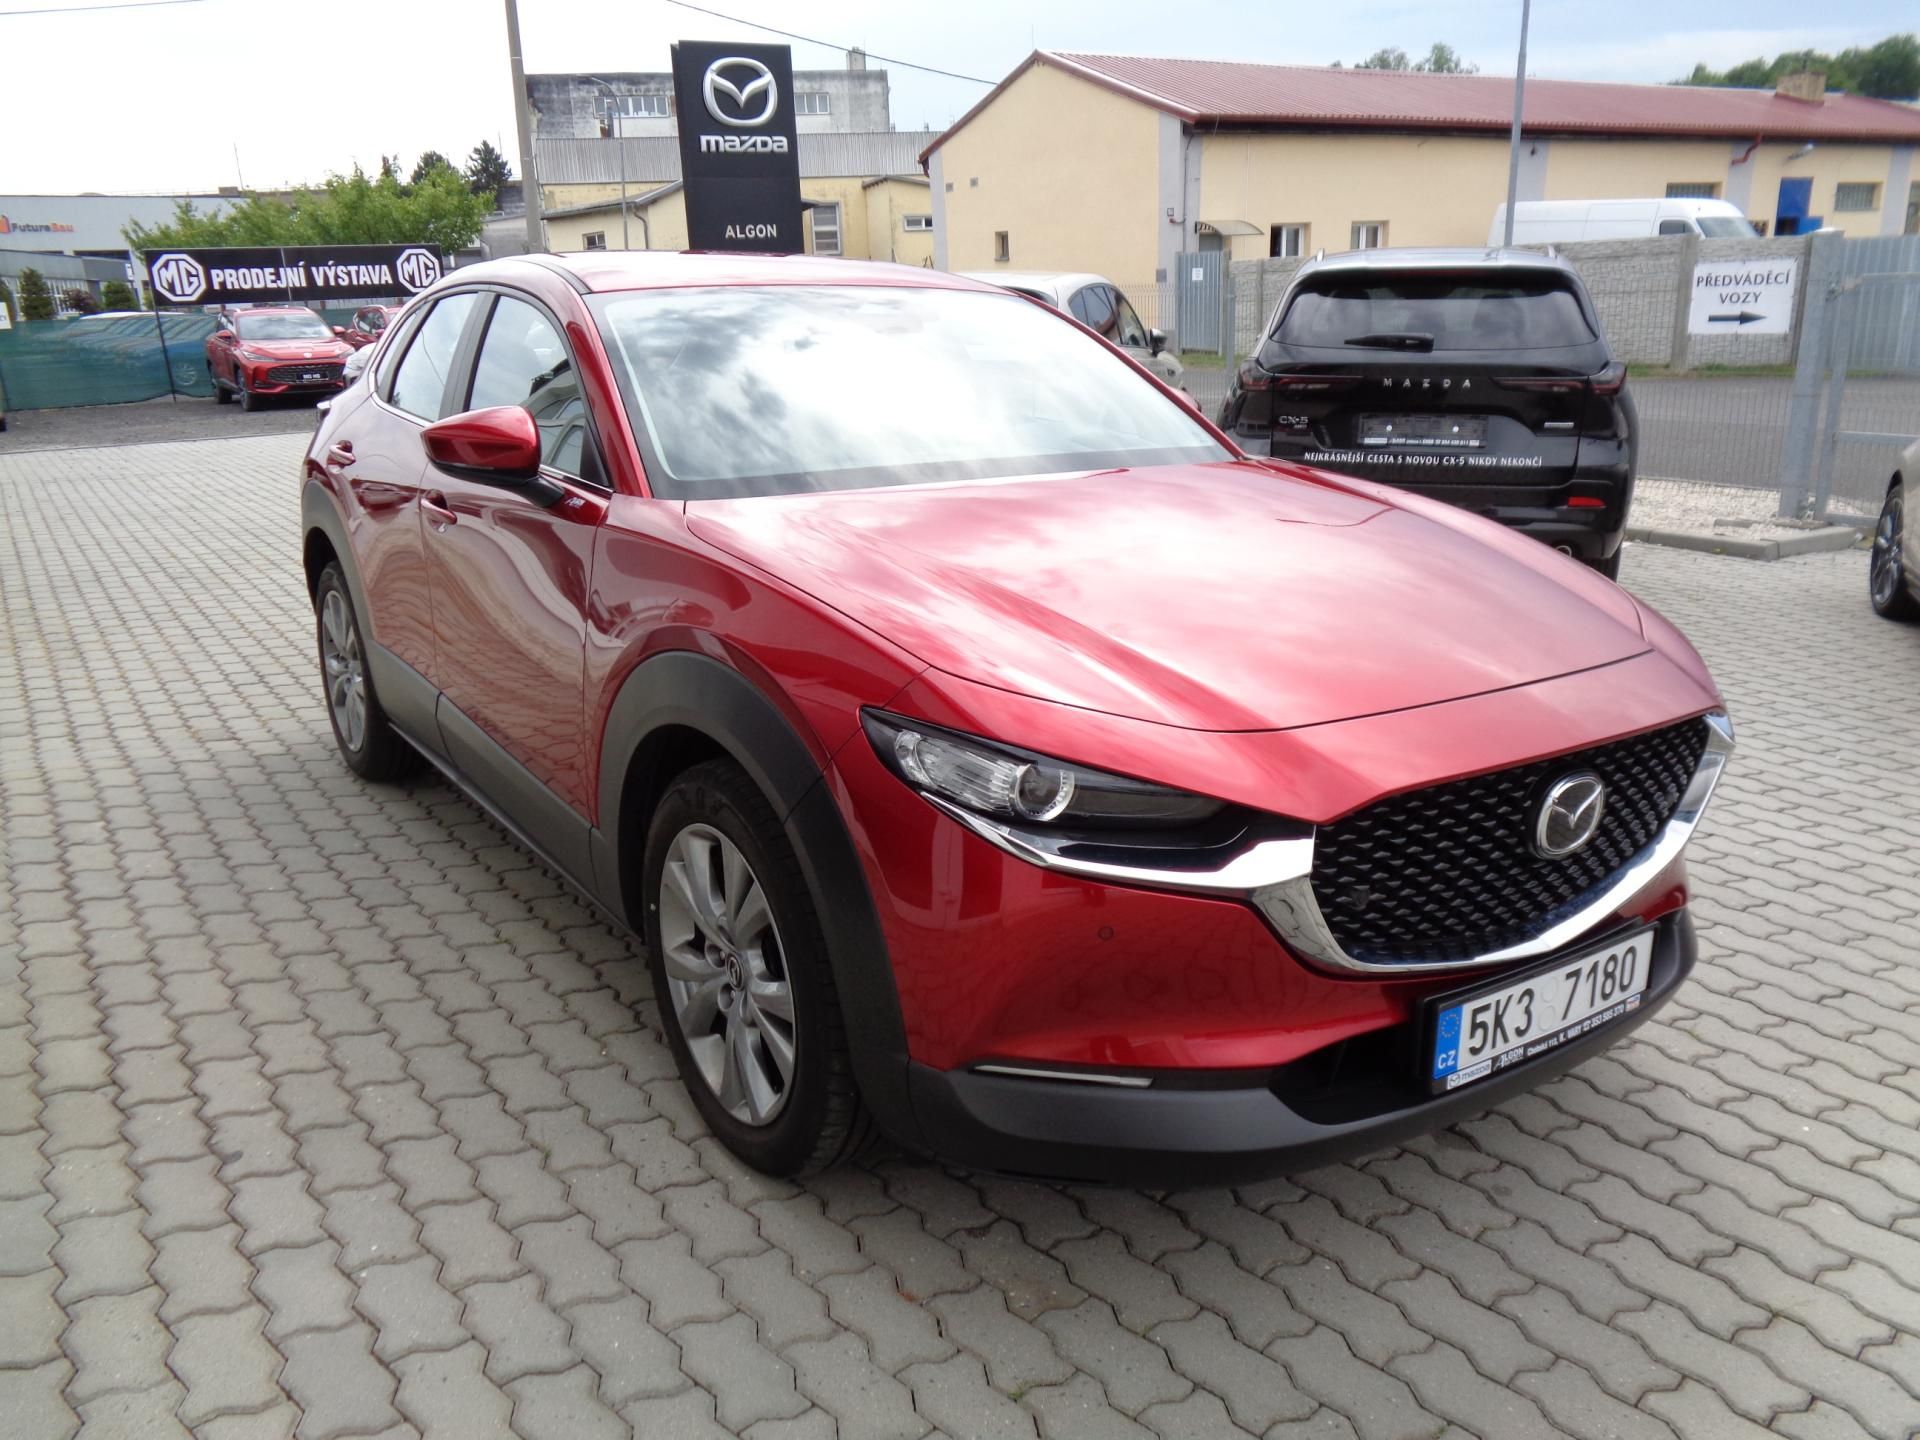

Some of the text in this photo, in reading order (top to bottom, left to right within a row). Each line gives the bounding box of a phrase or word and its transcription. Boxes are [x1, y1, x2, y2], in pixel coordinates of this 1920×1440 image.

[700, 135, 788, 153] mazda
[725, 224, 777, 239] ALGON
[157, 252, 437, 298] MG PRODEJNÍ VÝSTAVA MG
[1696, 268, 1791, 288] PŘEDVÁDĚCÍ
[1719, 291, 1762, 304] VOZY
[1383, 378, 1471, 389] MAZDA
[1279, 415, 1309, 424] CX-5
[1304, 451, 1542, 467] NEJKRÁSNĚJŠÍ CESTA S NOVOU CX-5 NIKDY NEKONČÍ
[1468, 945, 1637, 1056] 5K3 7180
[1437, 1049, 1457, 1069] CZ
